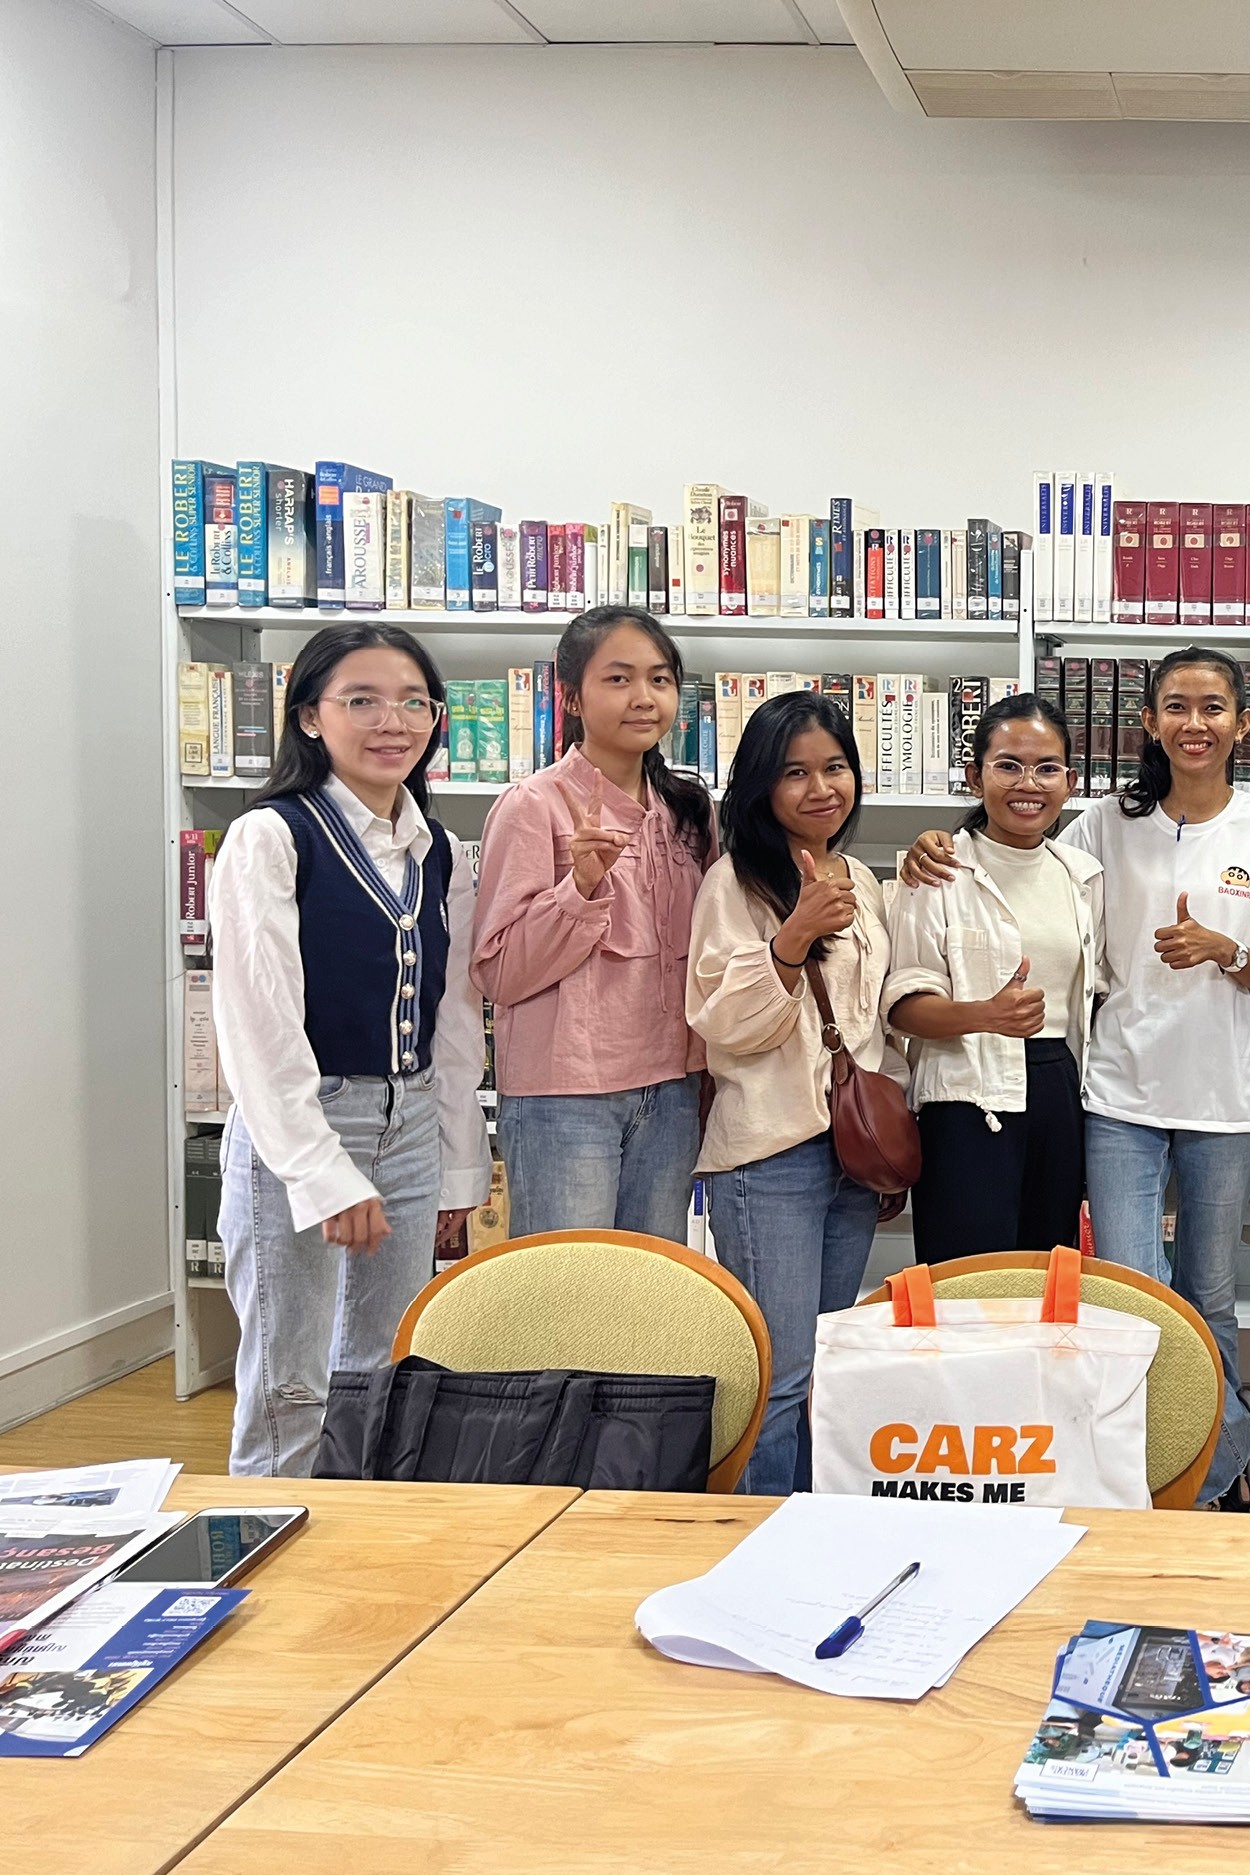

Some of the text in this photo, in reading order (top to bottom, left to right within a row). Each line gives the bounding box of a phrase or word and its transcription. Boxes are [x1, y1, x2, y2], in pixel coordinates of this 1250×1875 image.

[187, 463, 197, 495] SENIOR
[252, 465, 261, 498] SENIOR
[175, 464, 190, 572] LE ROBERT
[188, 497, 198, 525] SUPER
[239, 467, 254, 575] LE ROBERT
[252, 499, 262, 527] SUPER
[275, 493, 283, 531] shorter
[284, 478, 295, 546] HARRAP'S
[832, 499, 843, 534] RIMES
[723, 530, 731, 576] synonymes
[869, 556, 877, 597] CITATIONS
[953, 678, 962, 692] 2
[902, 700, 913, 771] YMOLOGIE
[962, 678, 981, 761] ROBERT
[870, 1423, 1056, 1475] CARZ
[872, 1481, 1026, 1504] MAKES ME
